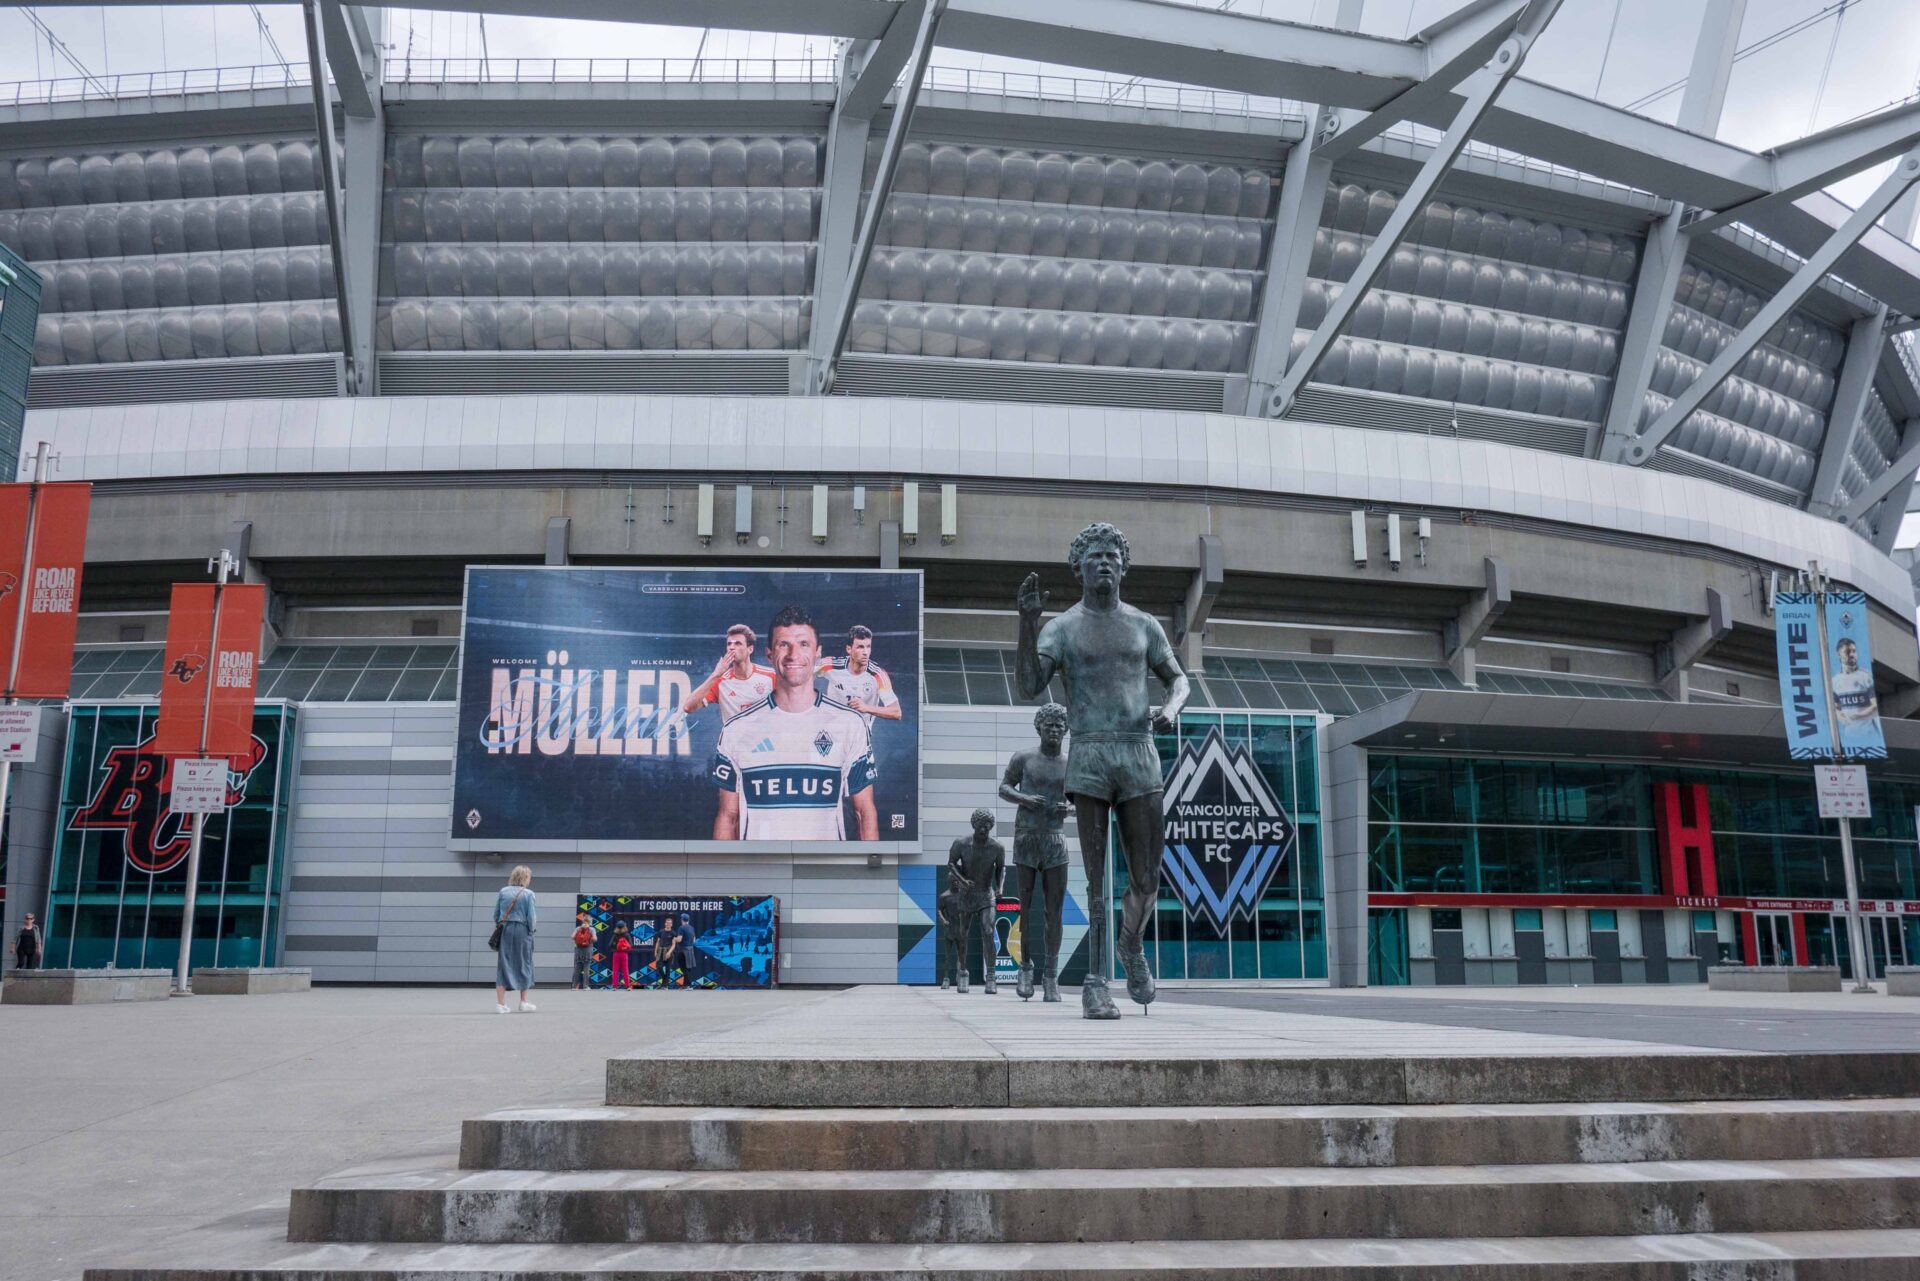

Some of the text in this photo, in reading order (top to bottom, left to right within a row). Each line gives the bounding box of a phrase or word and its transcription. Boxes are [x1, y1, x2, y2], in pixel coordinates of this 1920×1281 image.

[35, 567, 76, 589] ROAR
[31, 599, 73, 613] BEFORE
[219, 651, 254, 668] ROAR
[216, 676, 252, 688] BEFORE
[1787, 623, 1818, 739] WHITE
[487, 650, 692, 755] MÜLLER
[751, 778, 833, 796] TELUS
[1176, 804, 1260, 817] VANCOUVER
[1663, 783, 1719, 897] H
[1205, 844, 1232, 862] FC
[640, 901, 723, 911] IT'S GOOD TO BE HERE
[1676, 897, 1719, 907] TICKETS
[995, 958, 1013, 967] FIFA
